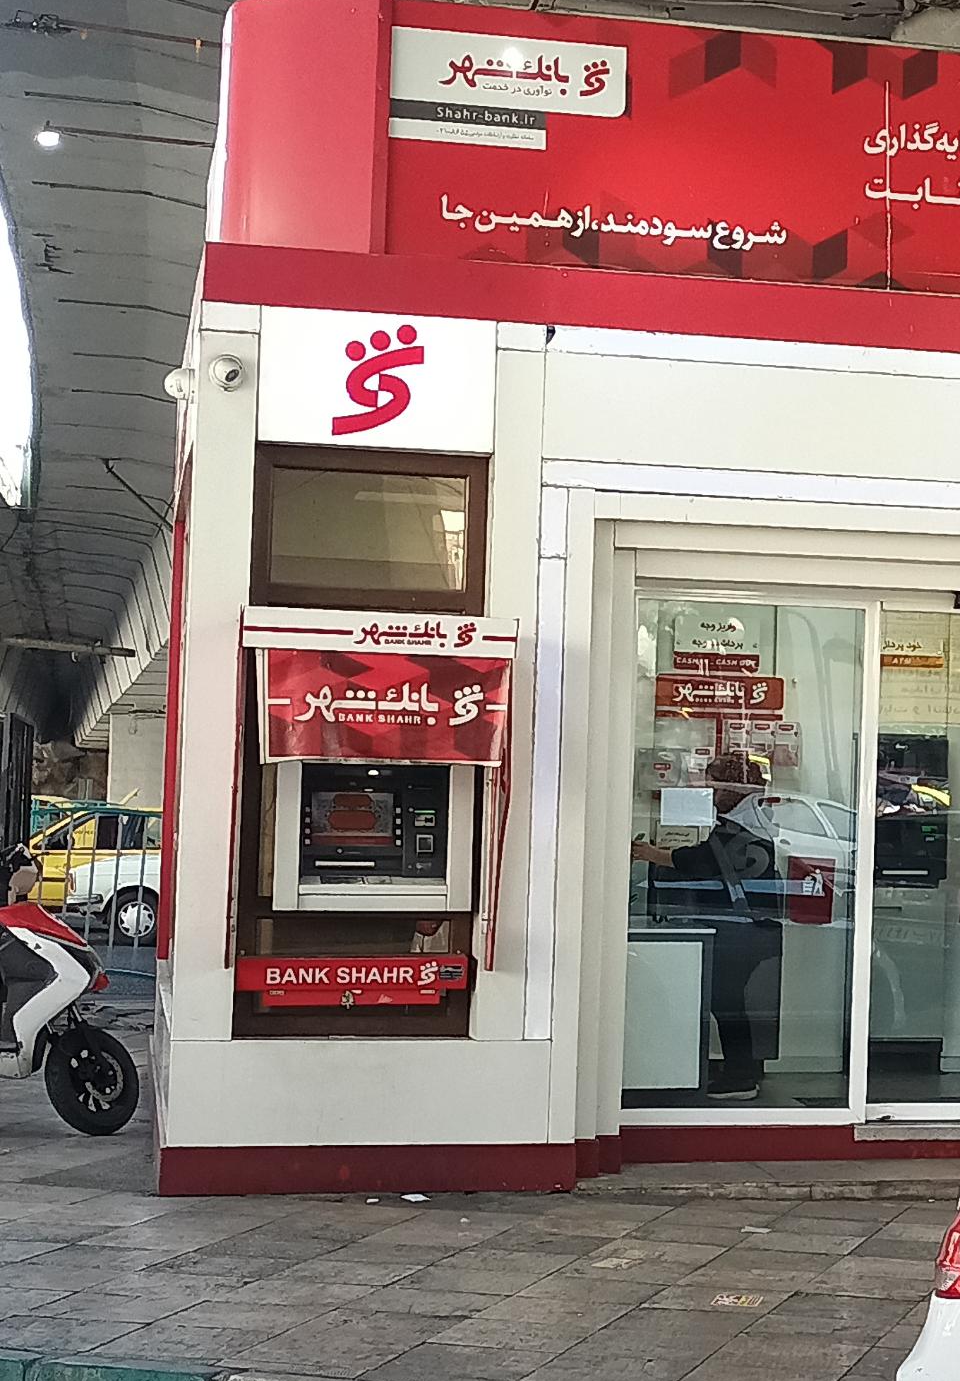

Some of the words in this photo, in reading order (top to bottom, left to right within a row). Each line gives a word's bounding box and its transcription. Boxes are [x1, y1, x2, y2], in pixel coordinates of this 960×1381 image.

[438, 54, 513, 87] شهر
[482, 82, 509, 92] خدمت
[511, 86, 521, 94] در
[523, 84, 552, 97] نوآوری
[571, 205, 591, 238] از
[712, 220, 787, 250] شروع
[353, 622, 407, 645] شهر
[700, 622, 716, 632] وجه
[294, 684, 376, 723] شهر
[338, 713, 374, 723] BANK
[378, 713, 421, 725] SHAHR
[266, 967, 330, 985] BANK
[336, 967, 413, 985] SHAHR
